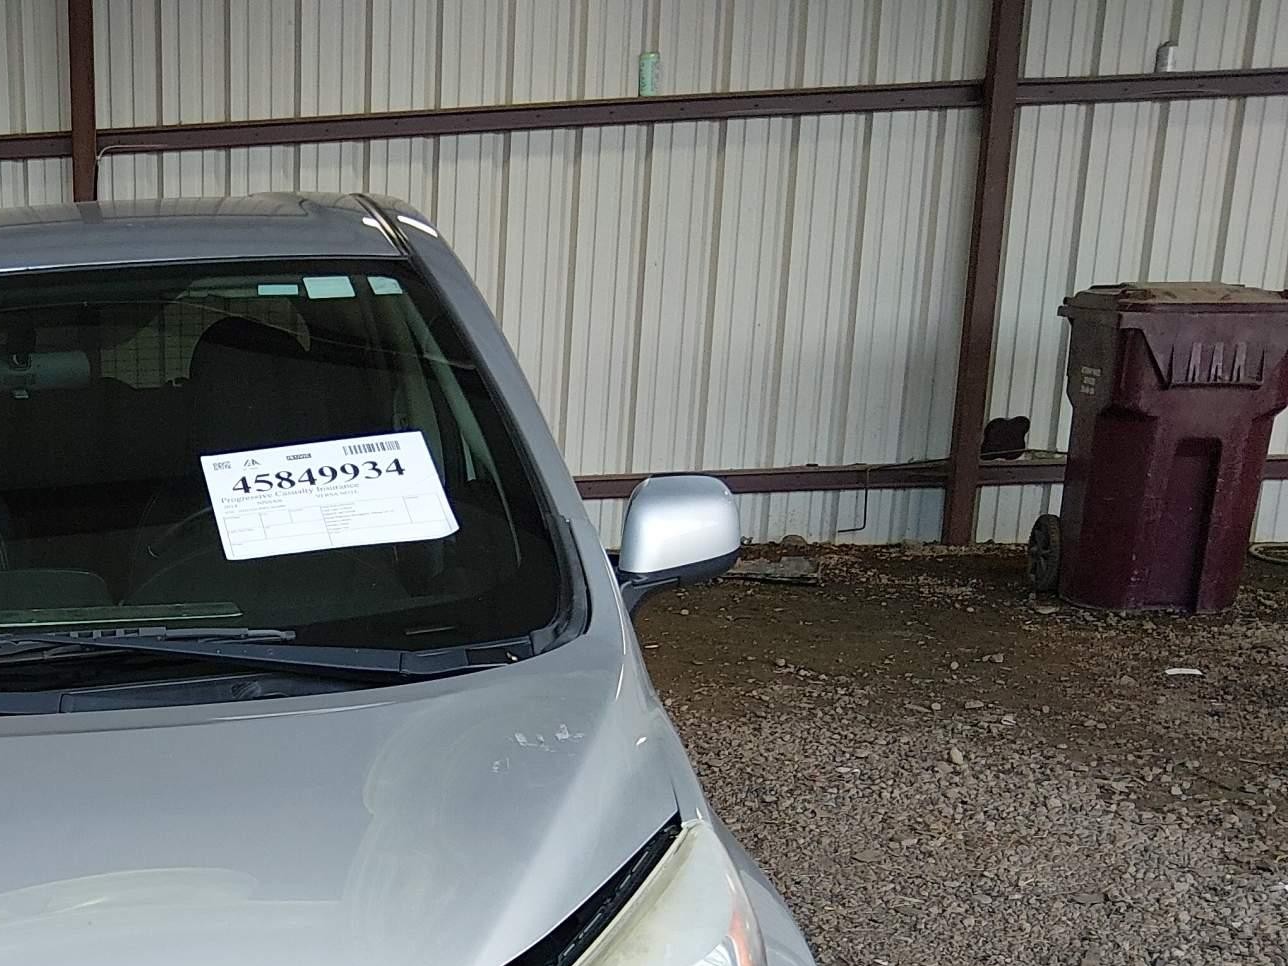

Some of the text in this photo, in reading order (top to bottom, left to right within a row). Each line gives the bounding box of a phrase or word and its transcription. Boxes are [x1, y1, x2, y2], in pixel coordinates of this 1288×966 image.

[232, 457, 406, 494] 45849934
[221, 483, 360, 504] Progressive Casualty Insurance
